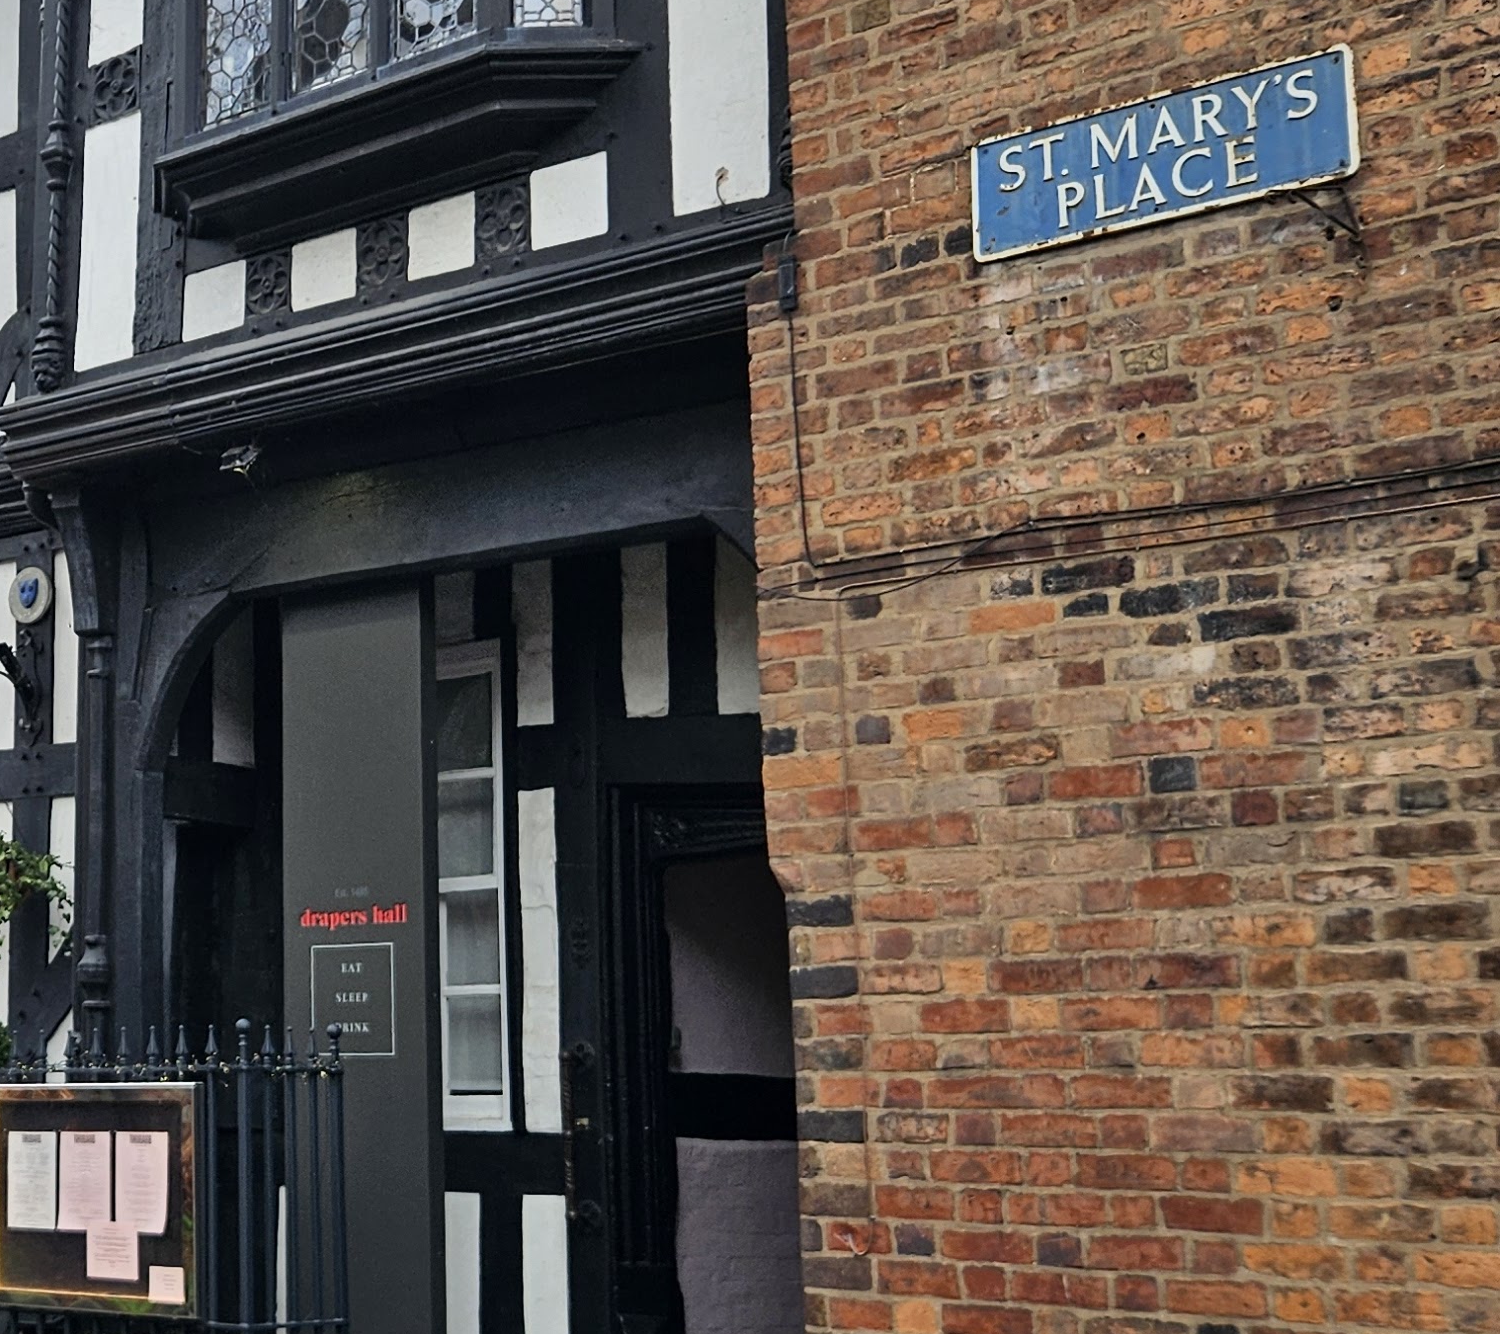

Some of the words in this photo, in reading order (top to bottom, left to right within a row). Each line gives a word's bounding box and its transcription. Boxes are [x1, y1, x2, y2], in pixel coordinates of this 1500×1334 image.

[1000, 133, 1069, 191] ST.
[1090, 69, 1319, 169] MARY'S
[1057, 135, 1259, 229] PLACE
[300, 908, 367, 931] drapers
[372, 903, 408, 924] hall
[341, 963, 362, 973] EAT
[335, 992, 369, 1003] SLEEP
